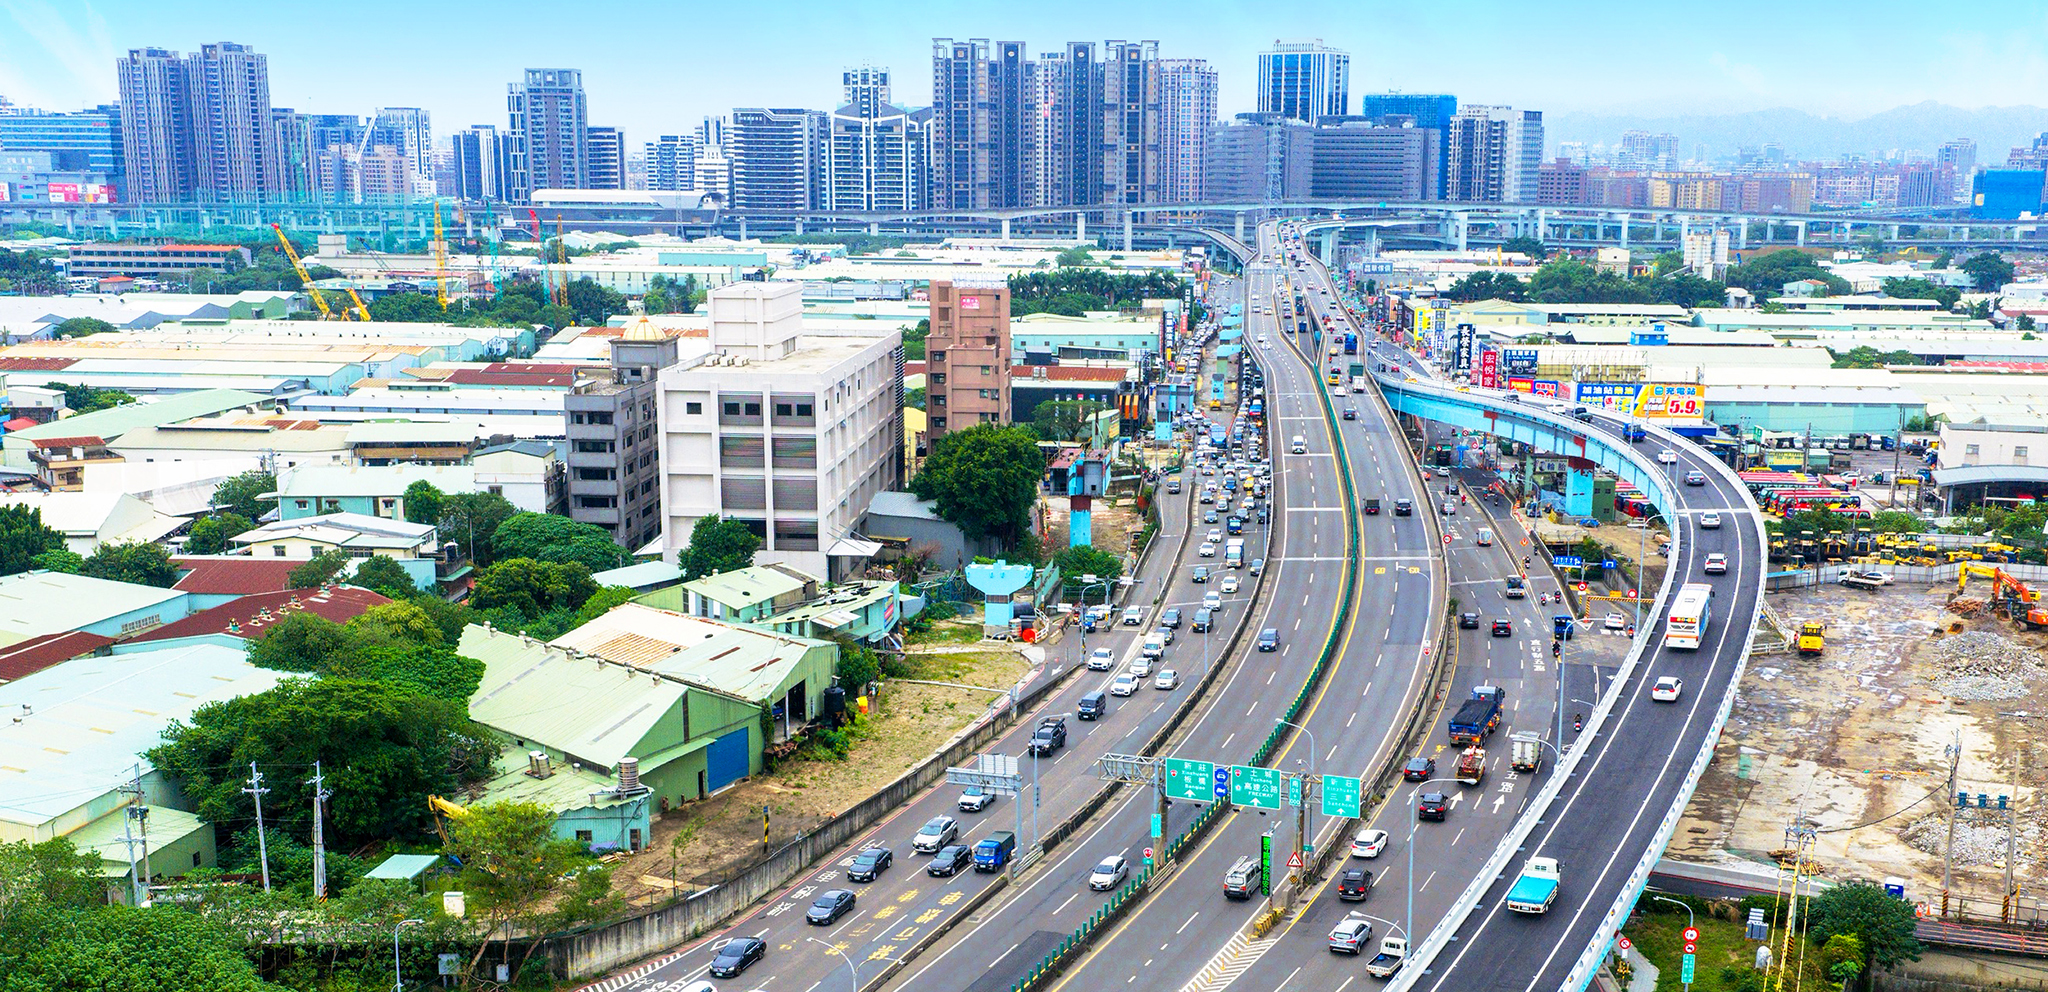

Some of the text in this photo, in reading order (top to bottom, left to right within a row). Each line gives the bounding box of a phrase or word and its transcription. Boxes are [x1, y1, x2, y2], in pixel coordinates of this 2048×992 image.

[1458, 325, 1470, 369] 長榮家具
[1665, 386, 1696, 395] 充電站
[1669, 400, 1696, 414] 5.9
[1250, 769, 1273, 779] 土城
[1184, 775, 1206, 786] 板橋
[1244, 782, 1278, 793] 高速公路
[1330, 793, 1353, 802] 三重
[868, 890, 965, 960] 禁行機車
